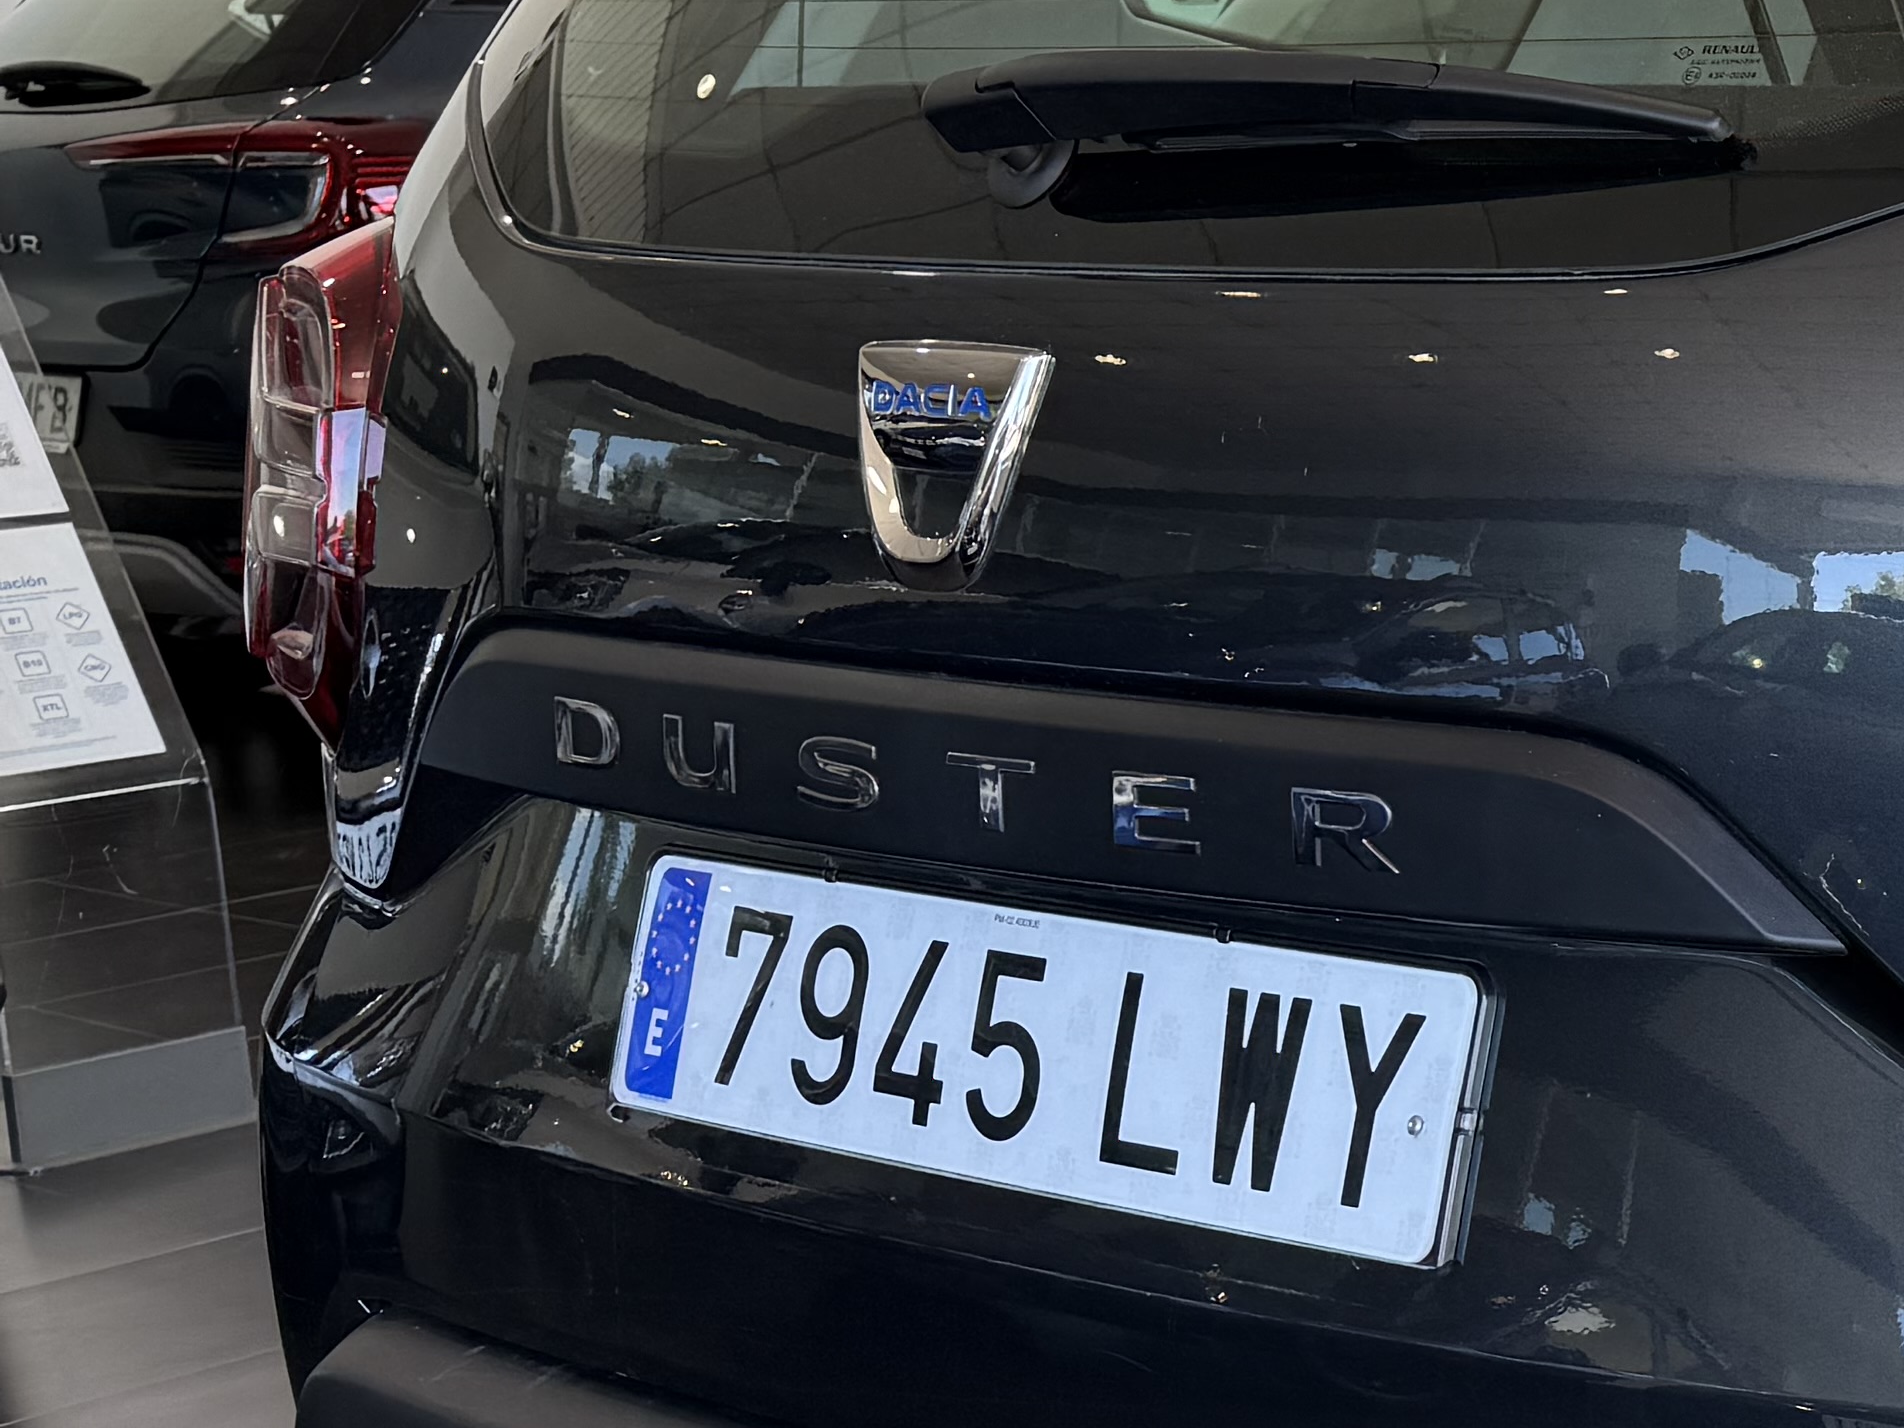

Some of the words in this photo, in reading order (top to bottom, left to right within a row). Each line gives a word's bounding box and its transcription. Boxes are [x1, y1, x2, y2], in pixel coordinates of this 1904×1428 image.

[871, 378, 993, 422] DACIA
[0, 575, 48, 591] ación
[554, 695, 1400, 874] DUSTER
[644, 1007, 669, 1056] E
[714, 906, 1048, 1143] 7945
[1099, 971, 1426, 1209] LWY
